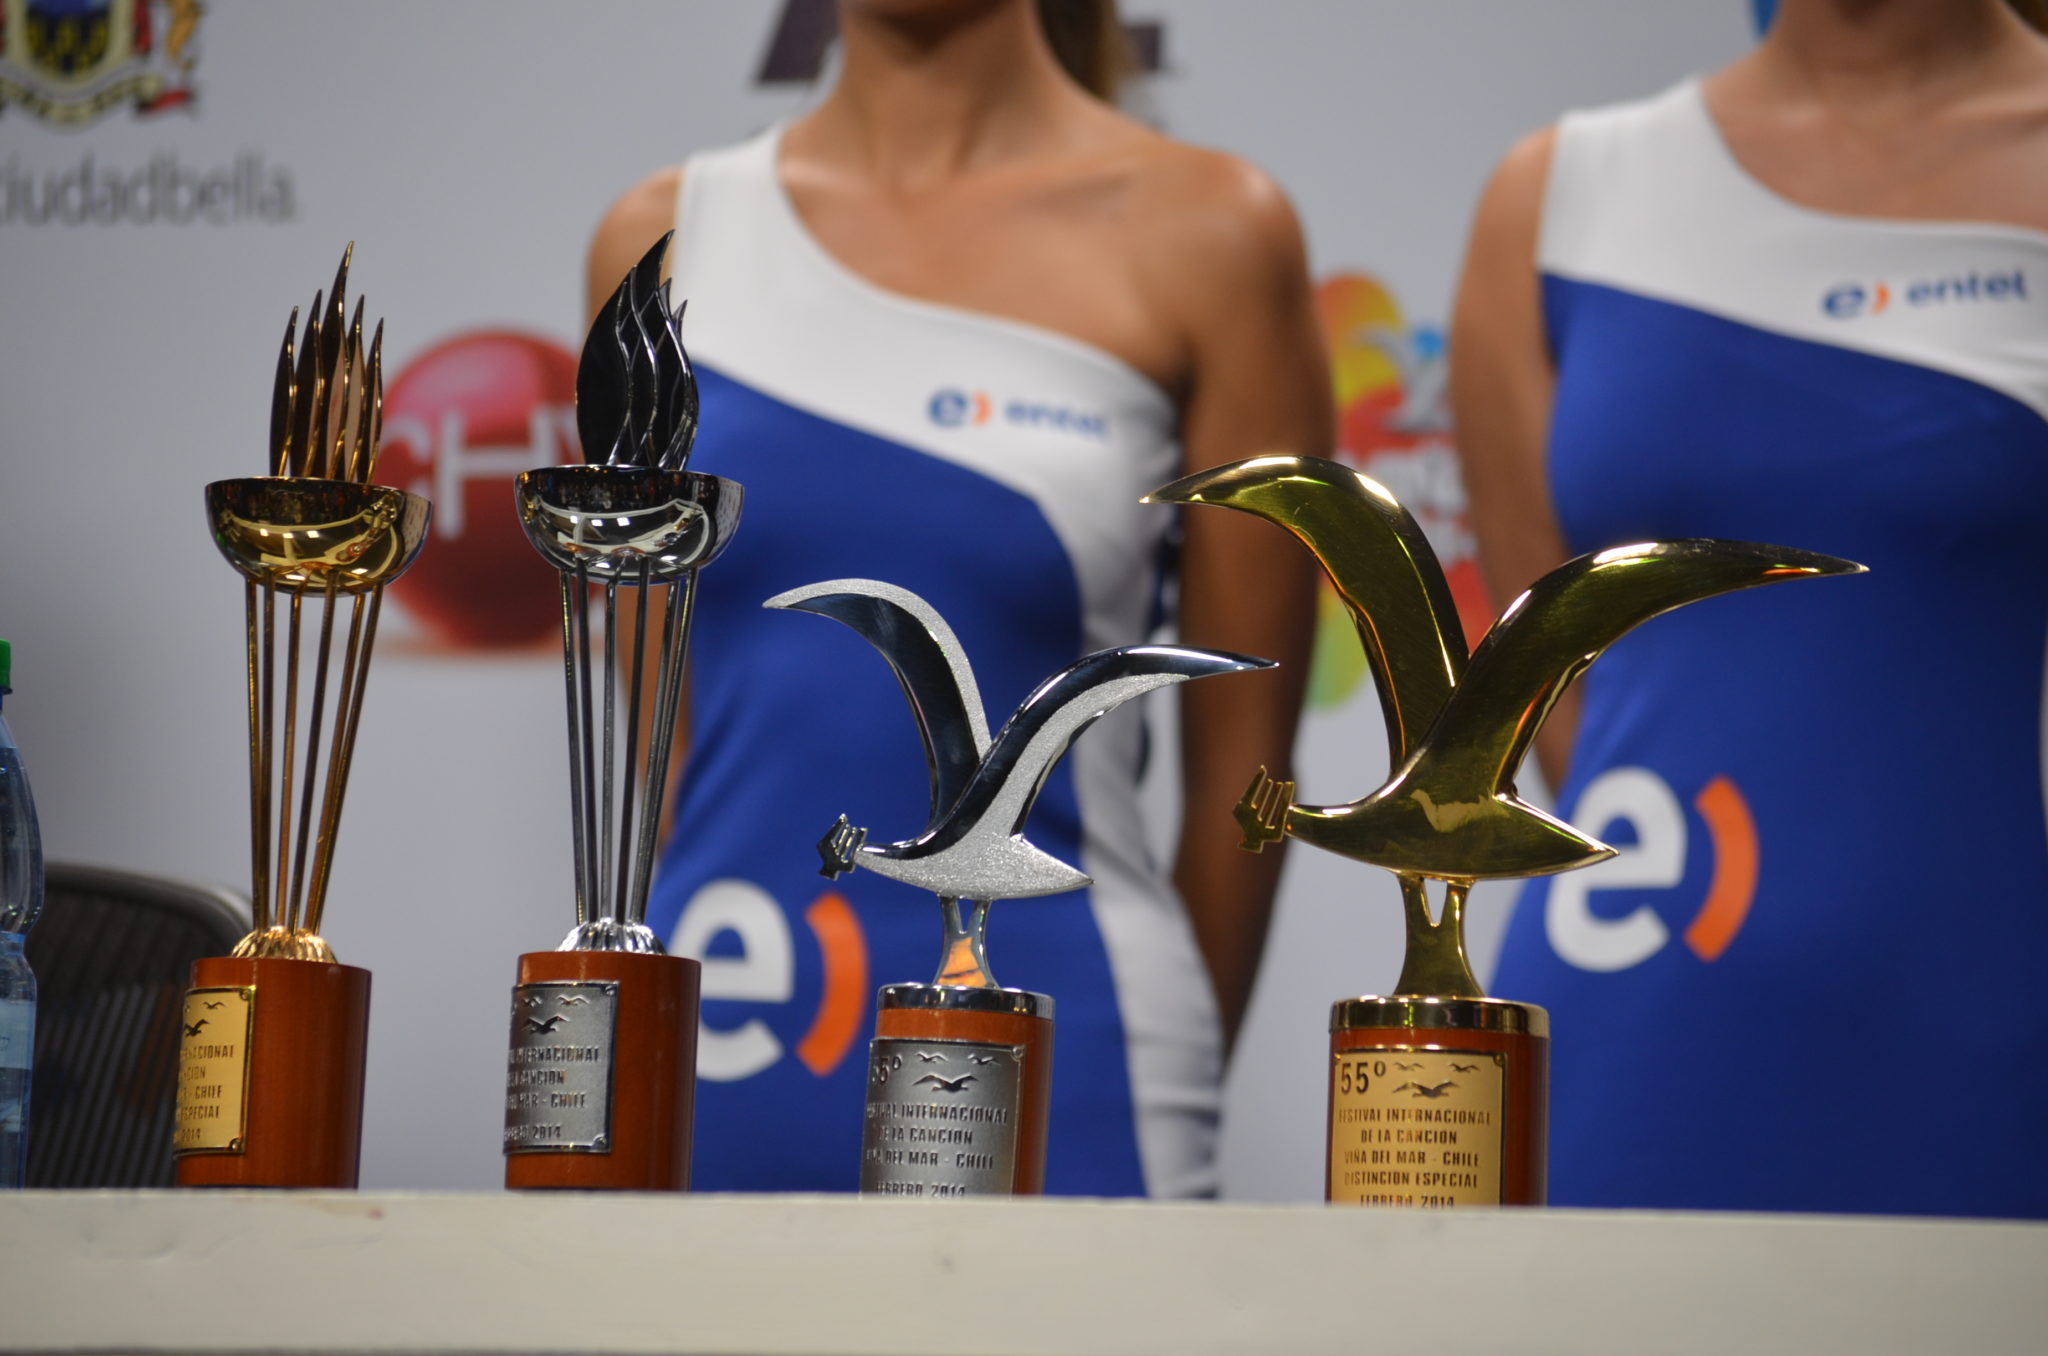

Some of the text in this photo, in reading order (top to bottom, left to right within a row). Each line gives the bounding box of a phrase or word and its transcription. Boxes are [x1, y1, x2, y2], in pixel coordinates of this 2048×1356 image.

[0, 149, 296, 226] iudadbella
[378, 402, 588, 540] CH
[550, 1093, 586, 1109] CHILE
[901, 1103, 1008, 1124] INTERNACIONAL
[1386, 1108, 1491, 1126] INTERNACIONAL
[532, 1125, 561, 1139] 2014
[909, 1127, 974, 1145] CANCION
[1361, 1129, 1458, 1145] DE LA CANCION
[908, 1151, 939, 1167] MAR
[1371, 1150, 1391, 1164] DEL
[1396, 1151, 1426, 1165] MAR
[1442, 1151, 1480, 1168] CHILE
[1344, 1171, 1479, 1189] DISTINCION ESPECIAL
[1420, 1194, 1455, 1209] 2014
